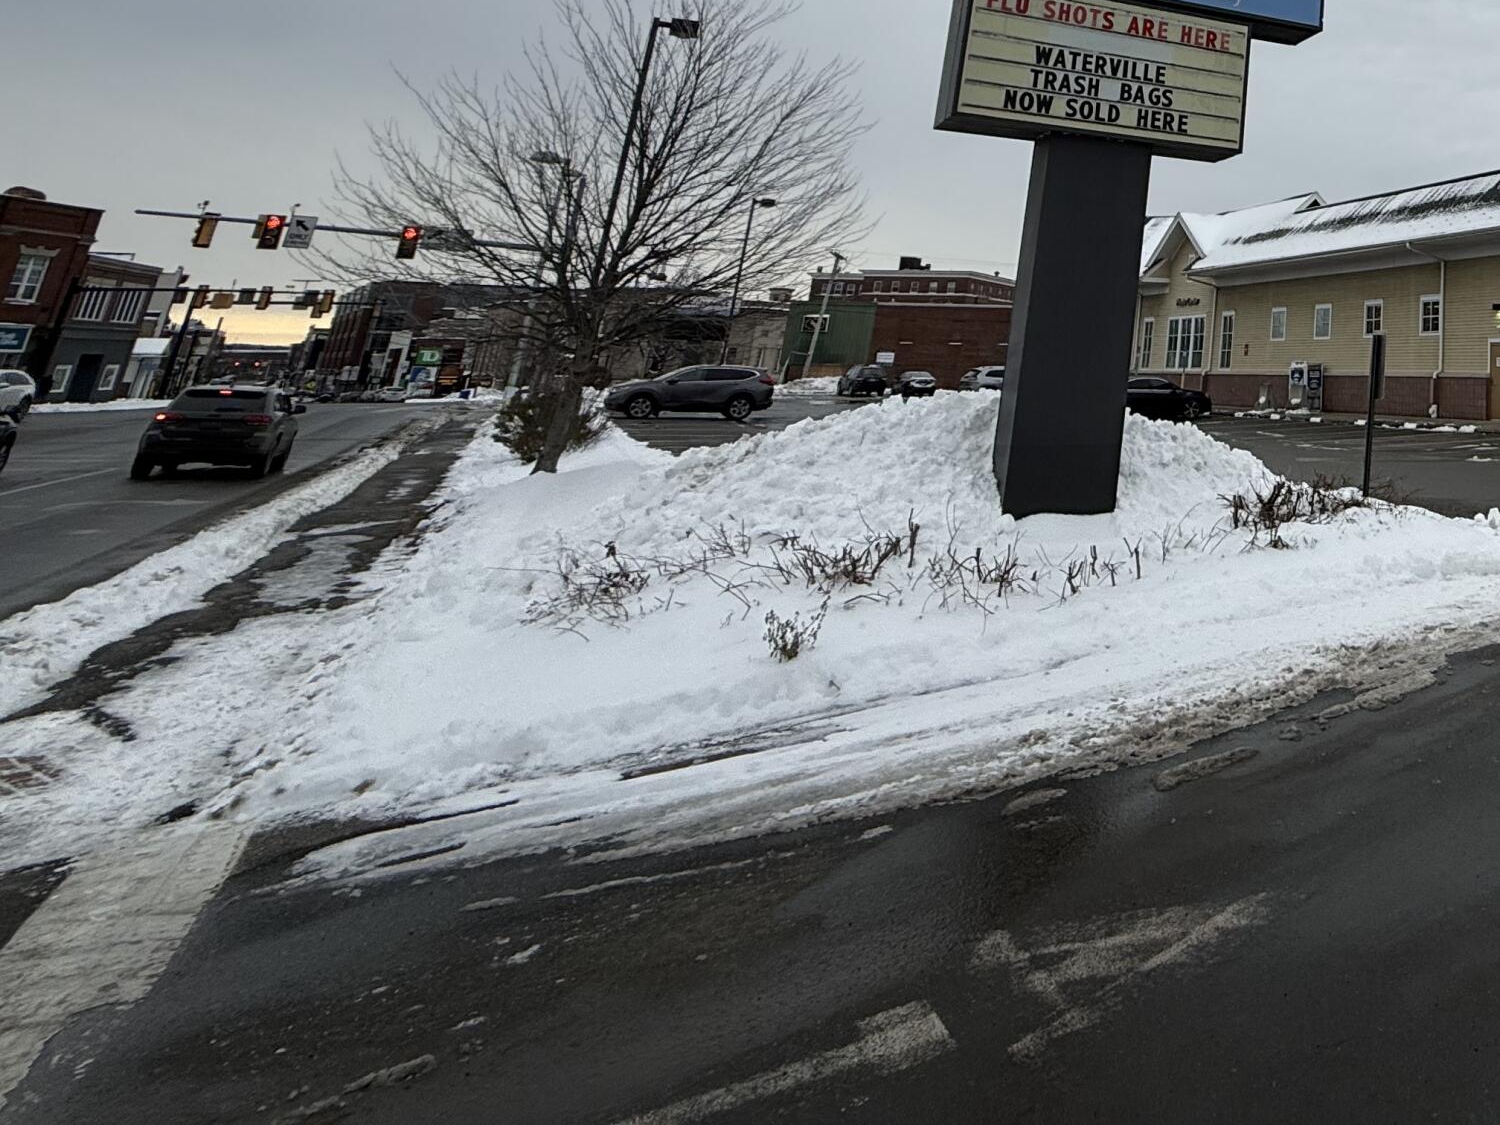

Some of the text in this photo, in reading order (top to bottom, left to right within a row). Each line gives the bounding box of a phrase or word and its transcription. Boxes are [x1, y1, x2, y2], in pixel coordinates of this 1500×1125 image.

[1043, 0, 1115, 30] SHOTS
[1127, 16, 1168, 40] ARE
[1180, 25, 1231, 51] HERE
[1035, 45, 1166, 84] WATERVILLE
[1030, 68, 1173, 107] TRASH BAGS
[1003, 89, 1188, 133] NOW SOLD HERE
